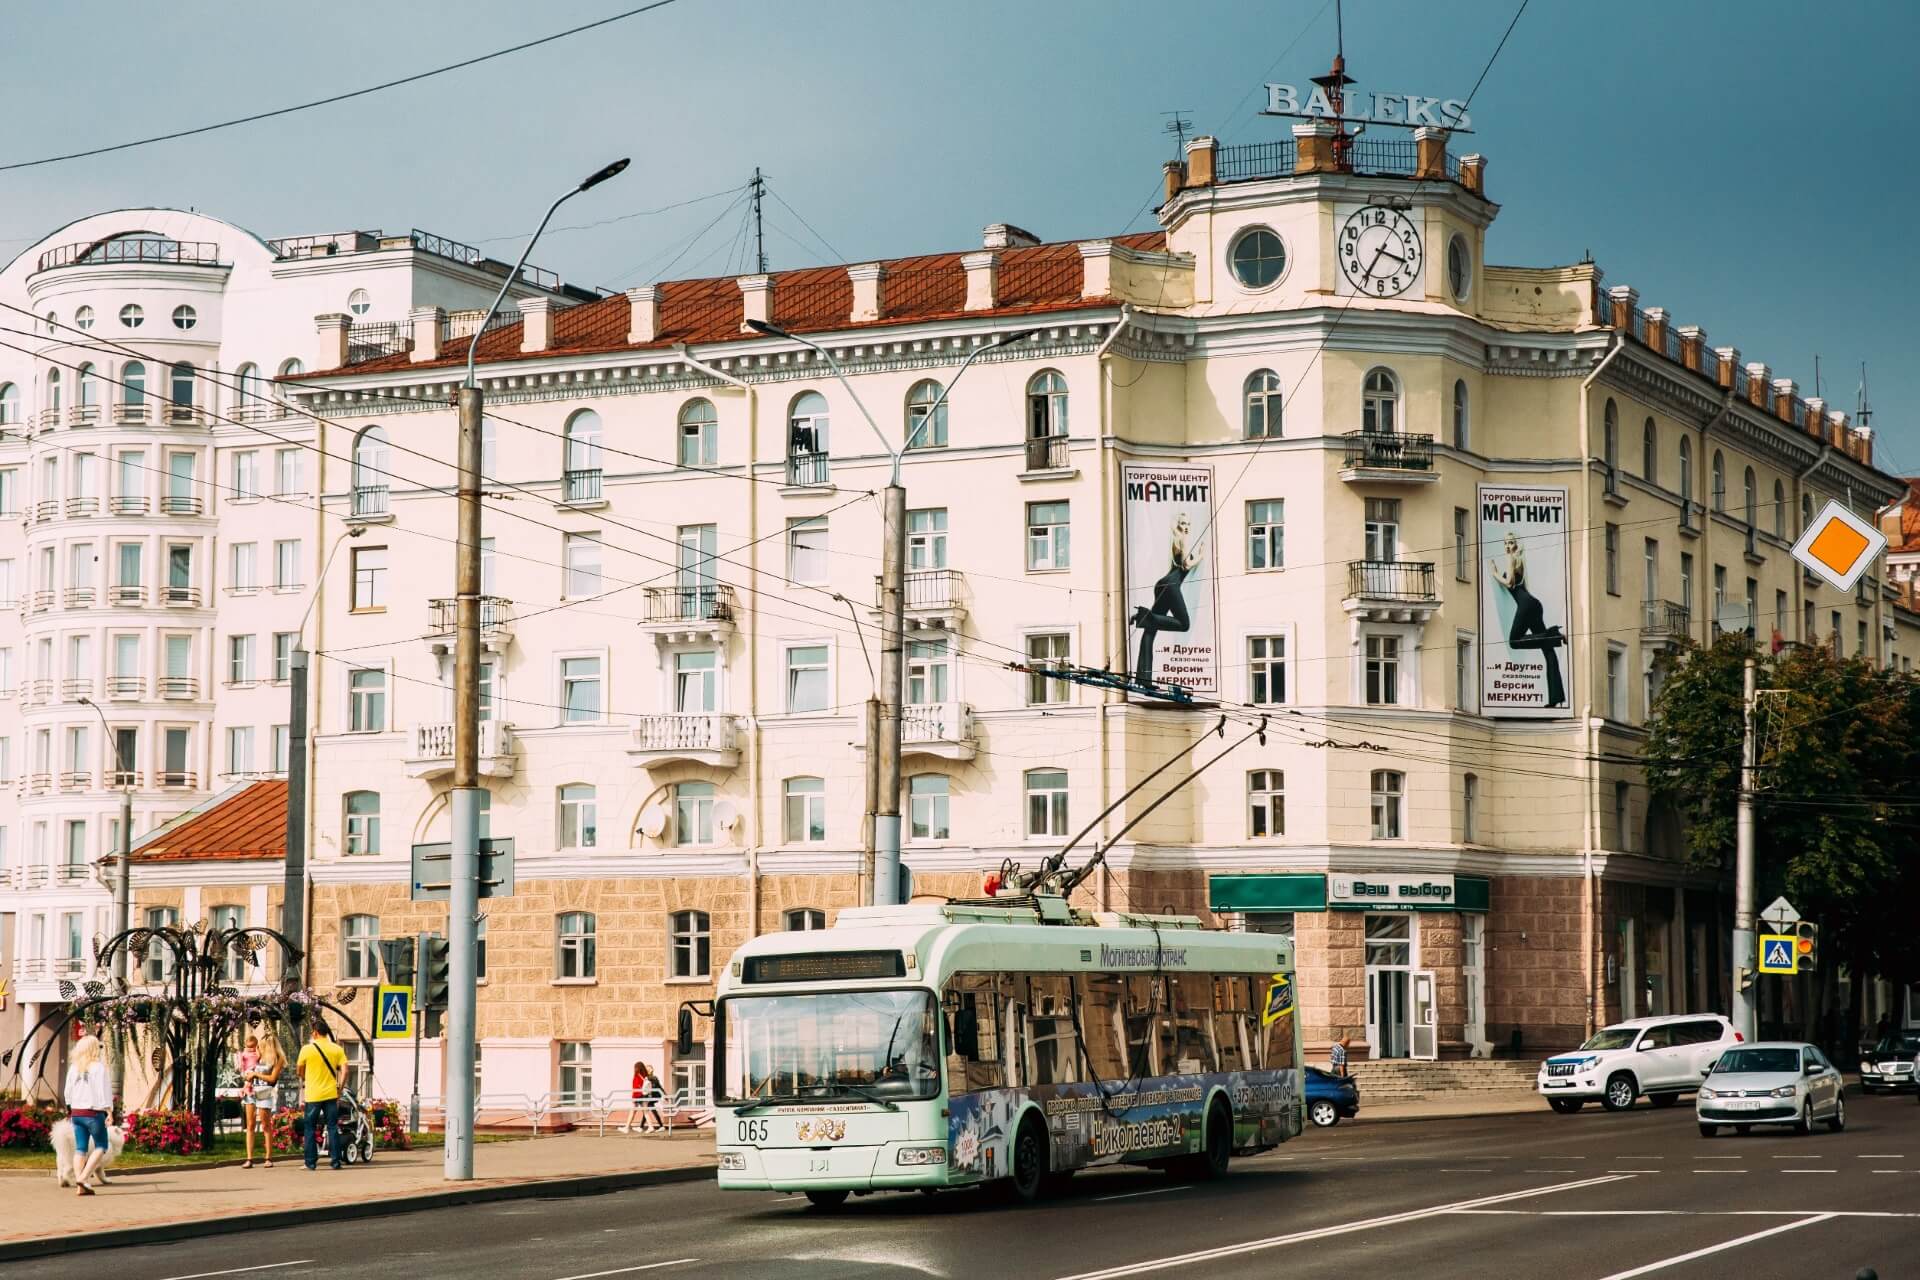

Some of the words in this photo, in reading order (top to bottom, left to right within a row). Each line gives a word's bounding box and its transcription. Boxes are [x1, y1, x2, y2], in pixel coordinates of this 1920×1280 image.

[1264, 82, 1472, 130] BALEKS
[1361, 214, 1369, 226] 11
[1375, 212, 1386, 224] 12
[1393, 216, 1398, 228] 1
[1347, 227, 1358, 239] 10
[1403, 231, 1412, 243] 2
[1345, 244, 1354, 256] 9
[1407, 249, 1416, 260] 3
[1350, 261, 1358, 273] 8
[1404, 264, 1412, 276] 4
[1376, 280, 1385, 292] 6
[1391, 278, 1400, 289] 5
[1127, 472, 1177, 481] ТОРГОВЫЙ
[1179, 474, 1209, 483] ЦЕНТР
[1127, 481, 1209, 502] МАГНИТ
[1482, 493, 1531, 503] ТОРГОВЫЙ
[1533, 495, 1562, 504] ЦЕНТР
[1482, 502, 1562, 523] МАГНИТ
[1172, 644, 1212, 656] Другие
[1162, 663, 1203, 675] Версии
[1504, 661, 1543, 672] Другие
[1493, 680, 1535, 691] Версии
[1487, 692, 1543, 703] МЕРКНУТ!
[1353, 881, 1390, 896] Ваш
[1398, 882, 1453, 901] выбор
[738, 1119, 769, 1142] 065
[1093, 1113, 1181, 1156] Николаевка-2
